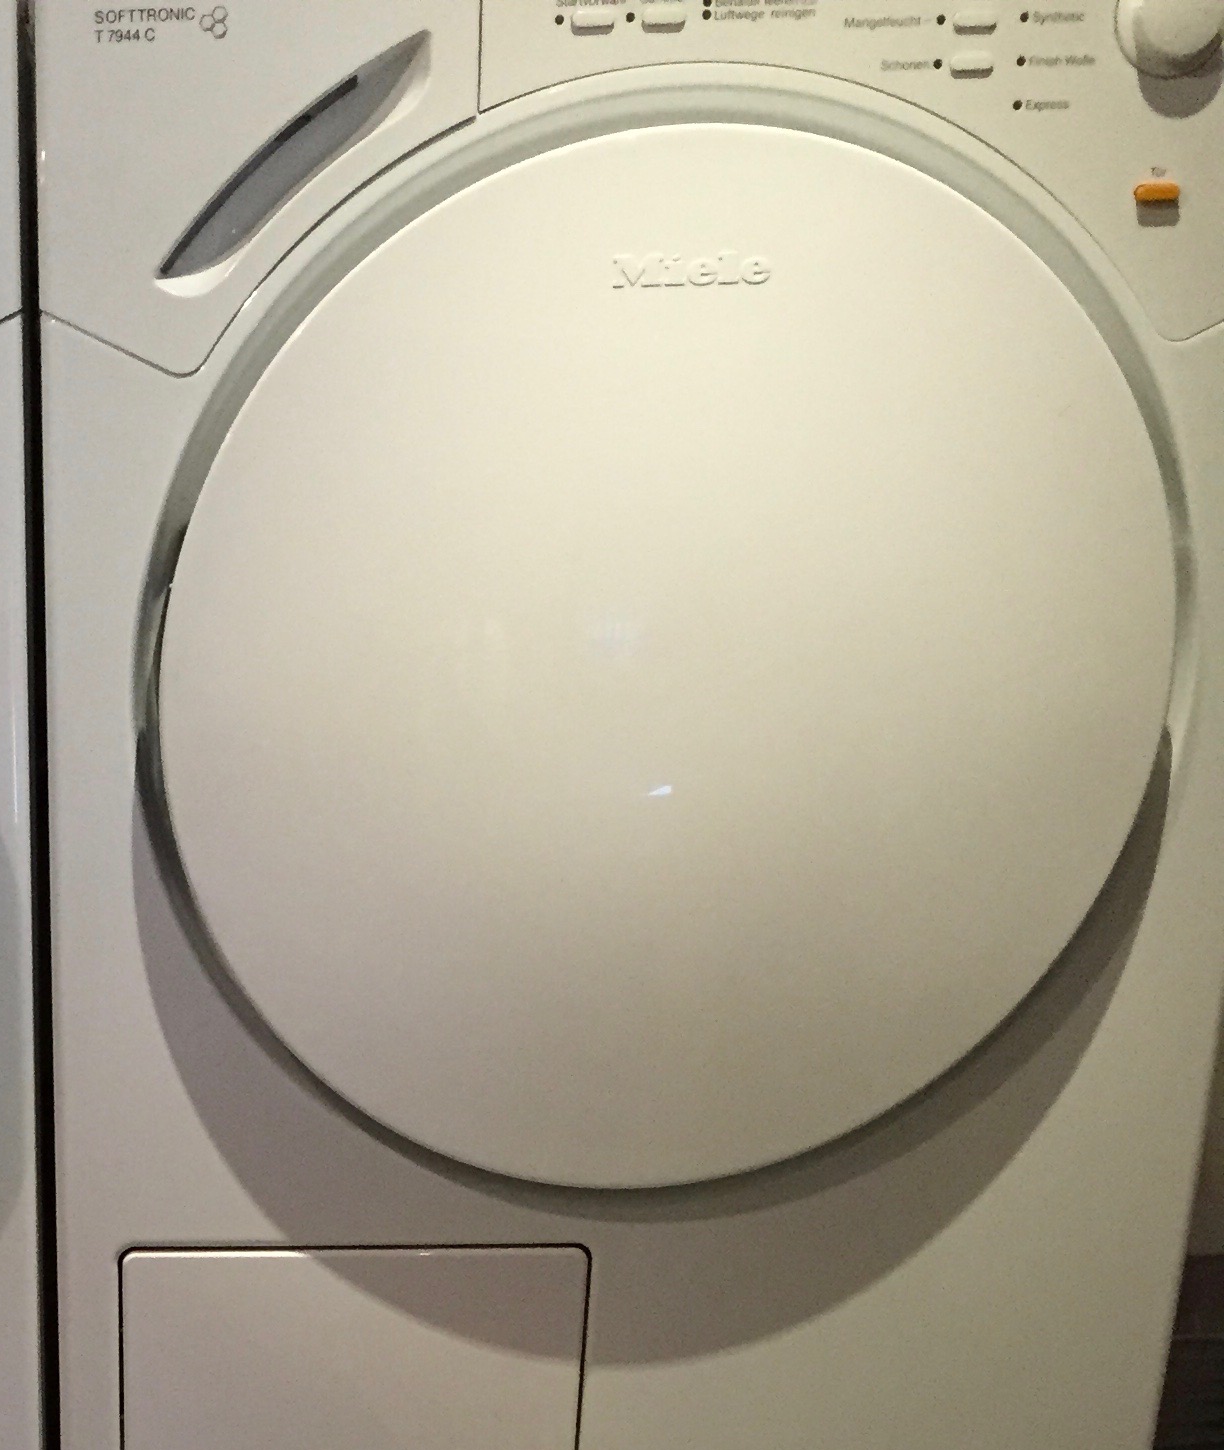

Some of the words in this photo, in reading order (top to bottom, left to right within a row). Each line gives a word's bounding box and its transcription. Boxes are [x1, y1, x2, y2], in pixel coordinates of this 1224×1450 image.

[94, 7, 196, 24] SOFTTRONIC
[94, 30, 104, 43] T
[108, 28, 140, 43] 7944
[144, 28, 156, 42] C
[1025, 100, 1070, 112] Express
[612, 249, 772, 290] Miele
